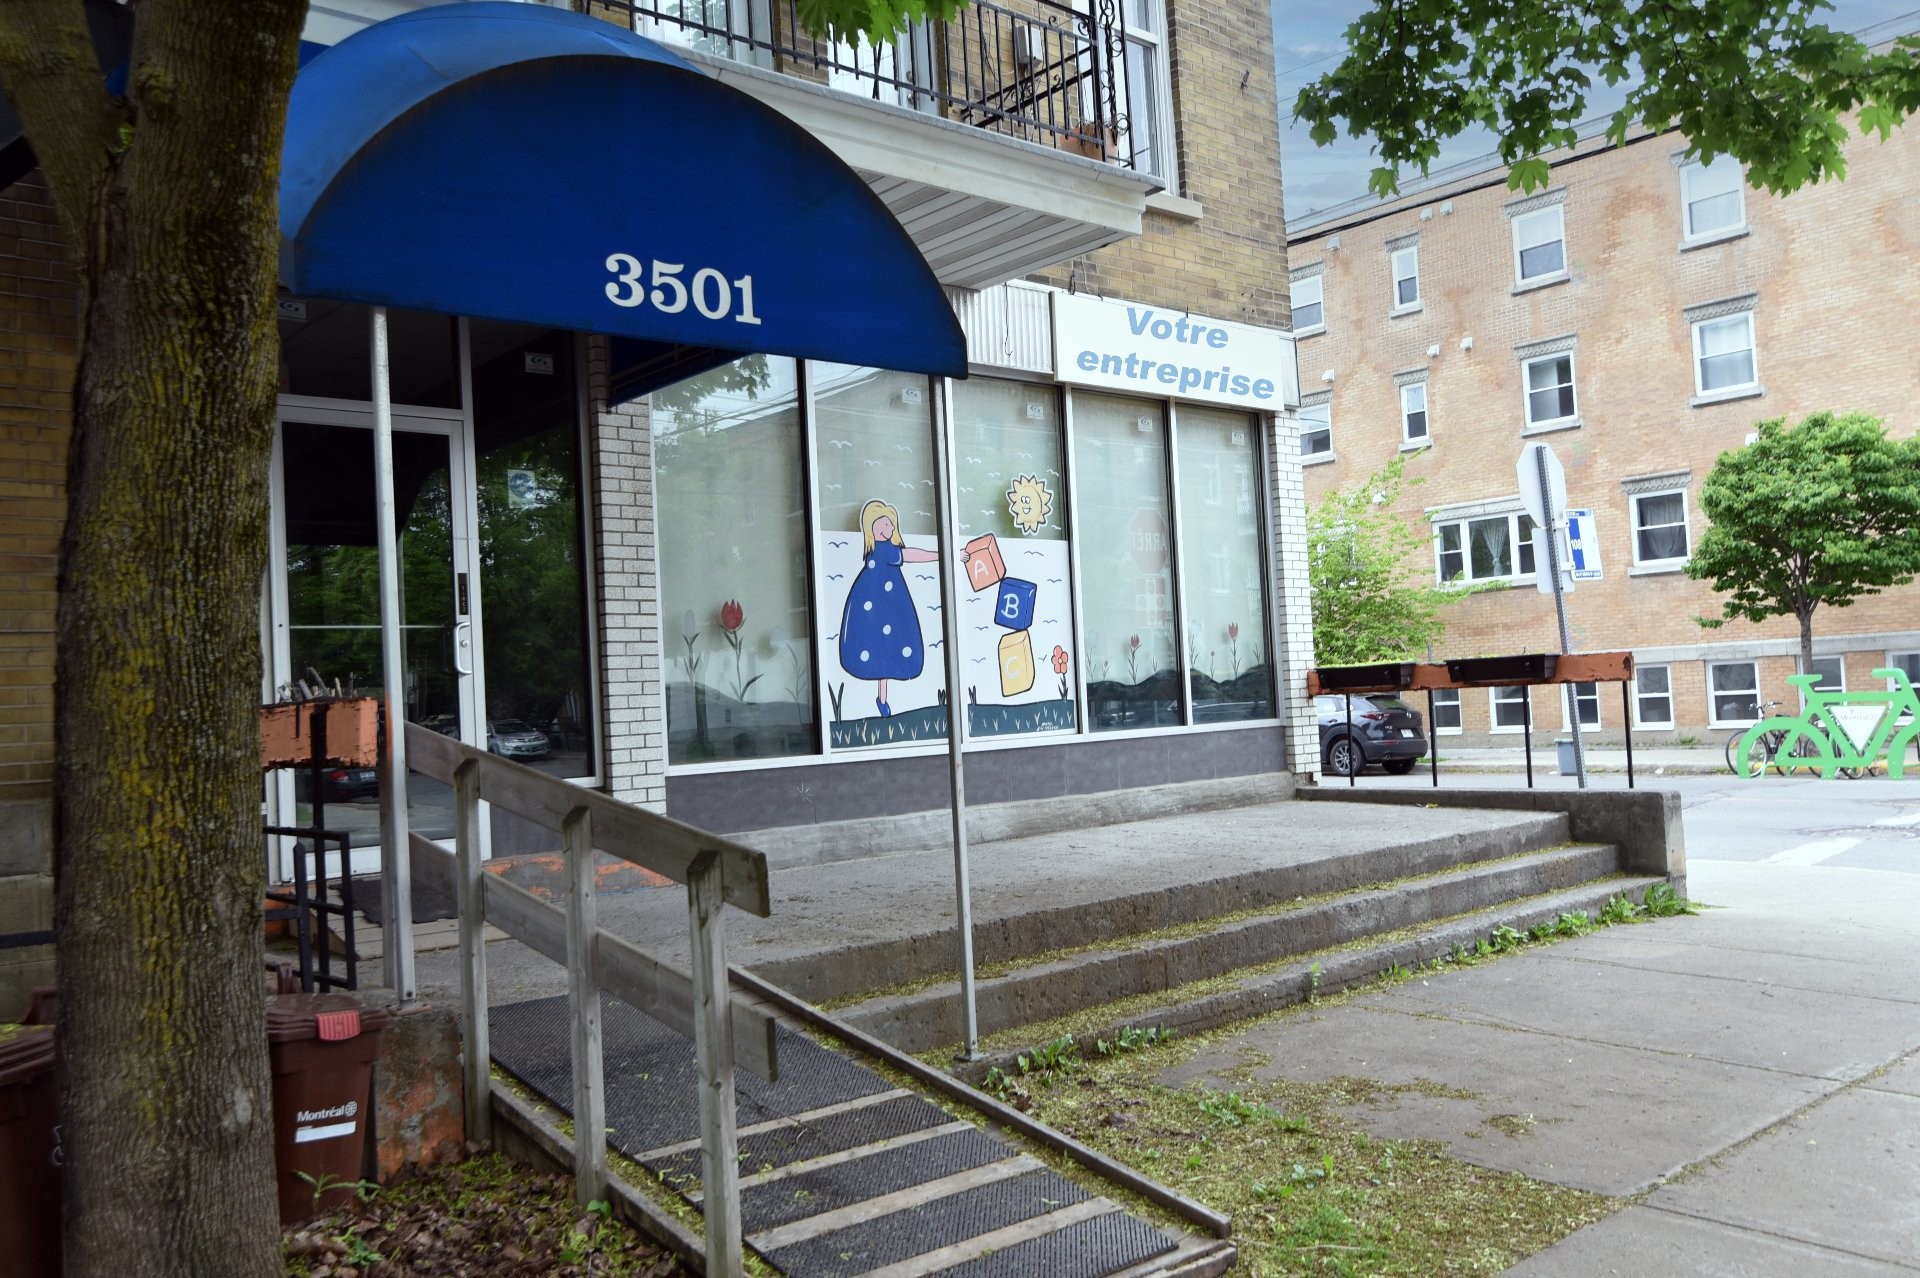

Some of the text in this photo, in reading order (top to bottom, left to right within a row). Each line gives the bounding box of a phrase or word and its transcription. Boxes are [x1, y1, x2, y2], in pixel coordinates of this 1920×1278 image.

[605, 253, 762, 325] 3501
[1126, 307, 1229, 349] Votre
[1076, 350, 1275, 400] entreprise
[974, 560, 989, 580] A
[1001, 593, 1019, 619] B
[1004, 656, 1021, 679] C
[297, 1105, 344, 1122] Montréal
